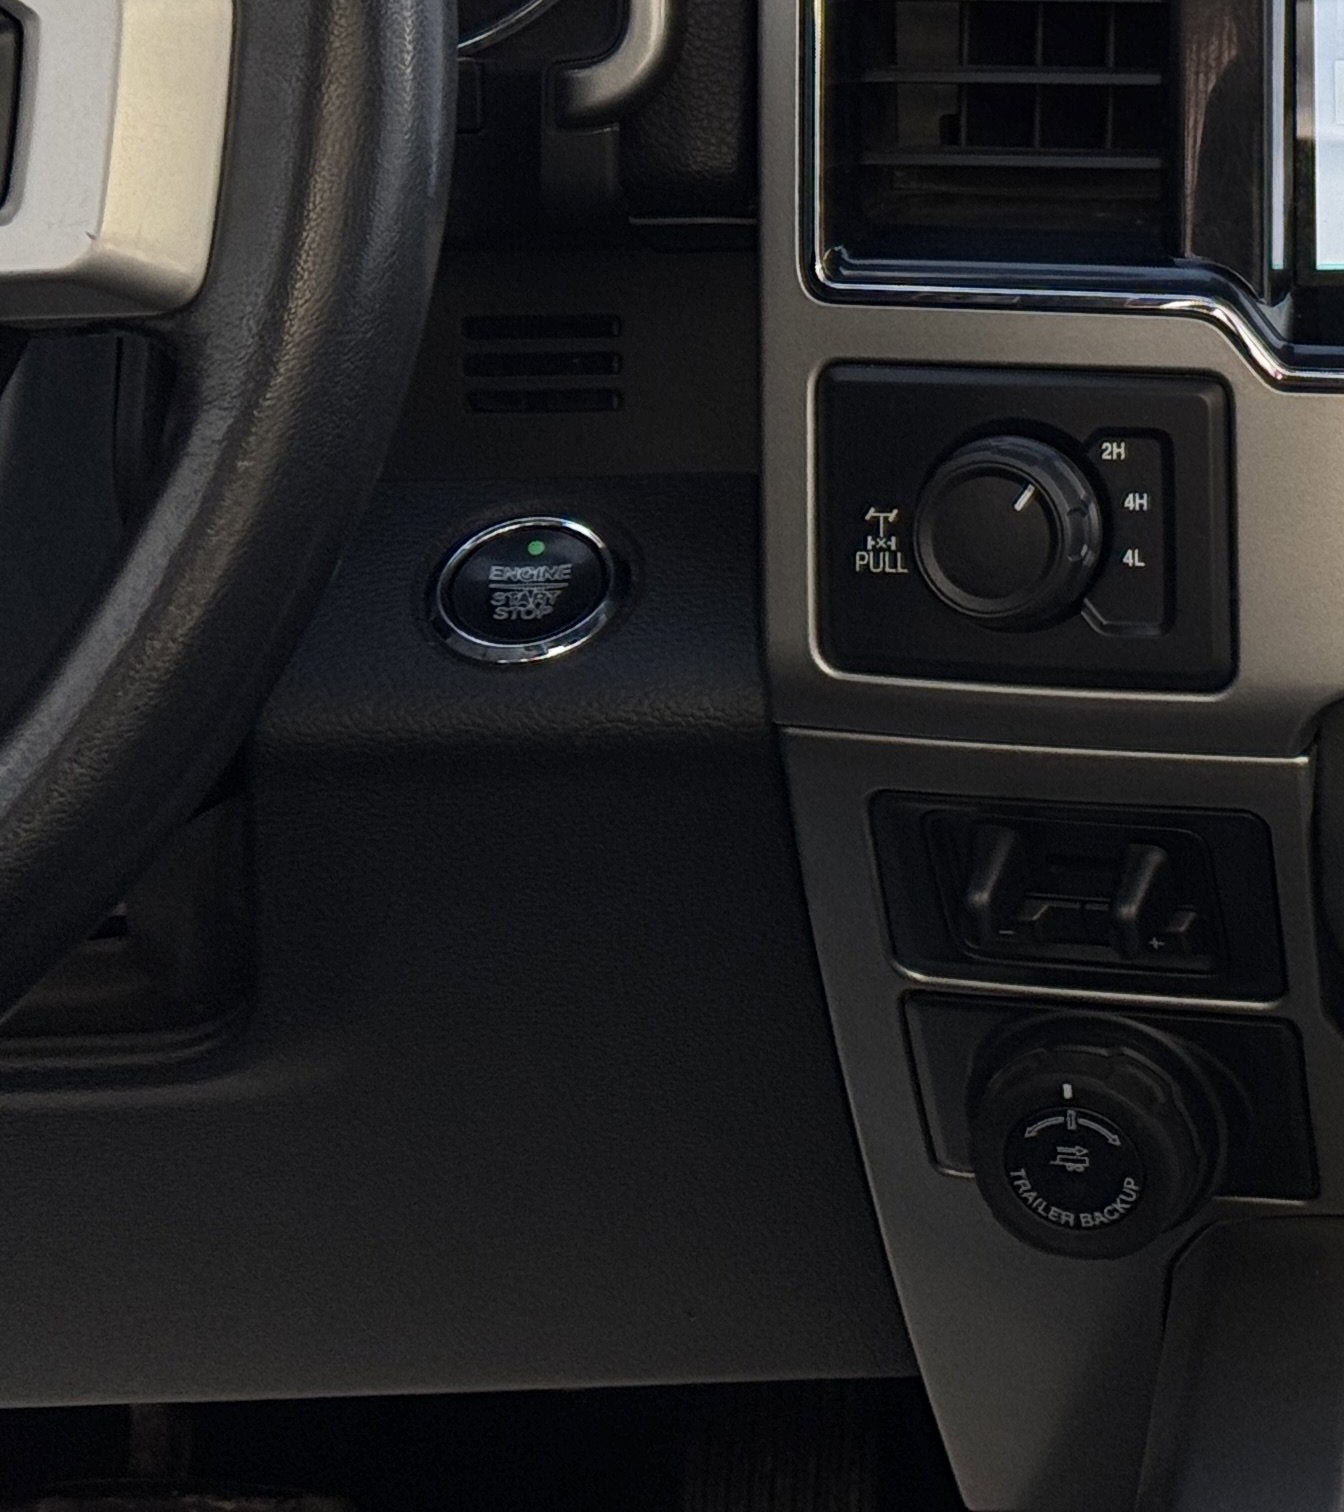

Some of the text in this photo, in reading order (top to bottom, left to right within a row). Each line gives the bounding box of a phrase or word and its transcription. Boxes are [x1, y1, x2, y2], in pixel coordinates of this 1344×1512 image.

[1101, 442, 1126, 460] 2H
[1124, 493, 1148, 511] 4H
[855, 551, 908, 573] PULL
[1122, 548, 1146, 567] 4L
[489, 564, 573, 581] ENGINE
[490, 590, 562, 605] START
[493, 607, 552, 620] STOP
[1010, 1168, 1141, 1228] TRAILER BACKUP
